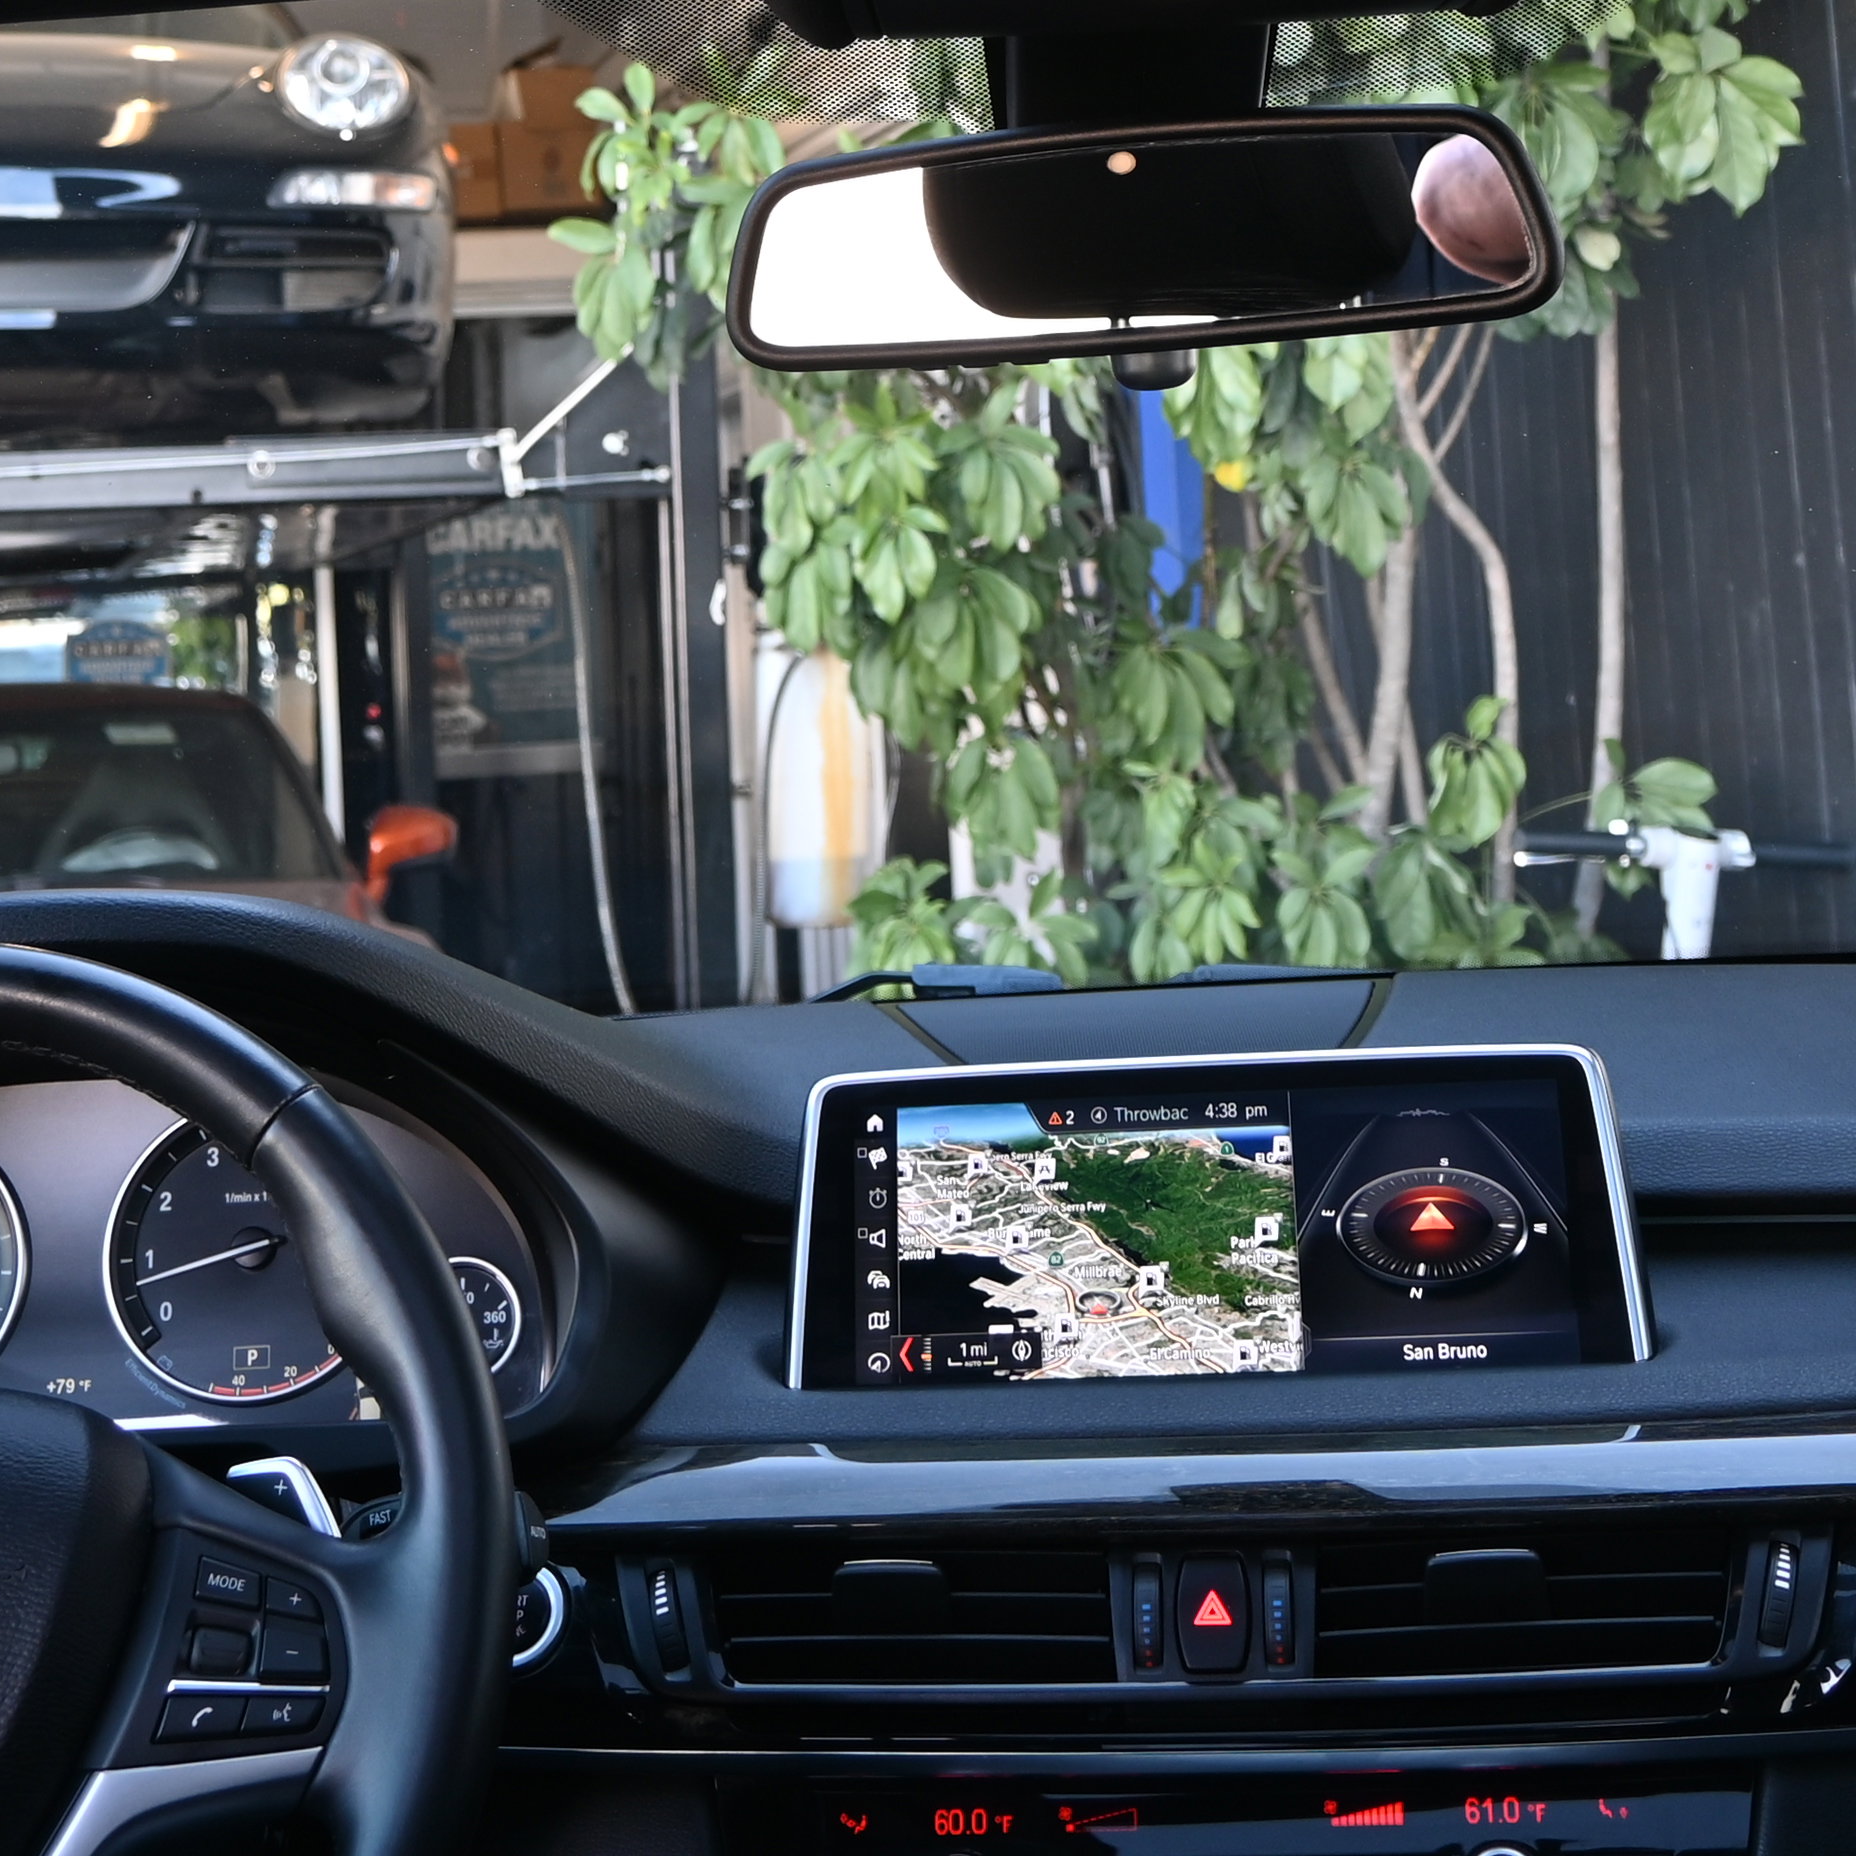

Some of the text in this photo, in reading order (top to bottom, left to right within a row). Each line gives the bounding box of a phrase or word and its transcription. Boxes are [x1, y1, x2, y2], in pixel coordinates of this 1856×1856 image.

[1066, 1102, 1268, 1124] 2 Throwbac 4:38 pm
[206, 1147, 219, 1167] 3
[1440, 1158, 1449, 1166] S
[159, 1192, 172, 1211] 2
[224, 1192, 252, 1203] 1/min
[145, 1249, 154, 1269] 1
[1074, 1265, 1122, 1279] Millbrae
[1197, 1294, 1220, 1306] Blvd
[1409, 1287, 1423, 1299] N
[159, 1302, 172, 1321] 0
[483, 1311, 507, 1324] 360
[247, 1349, 258, 1365] P
[960, 1343, 988, 1357] 1 mi
[1403, 1343, 1488, 1361] San Bruno
[284, 1366, 298, 1378] 20
[46, 1379, 92, 1394] +79 °F
[232, 1375, 245, 1387] 40
[369, 1509, 392, 1527] FAST
[207, 1572, 246, 1592] MODE
[1465, 1796, 1546, 1824] 61.0 °F
[934, 1809, 1013, 1835] 60.0 °F
